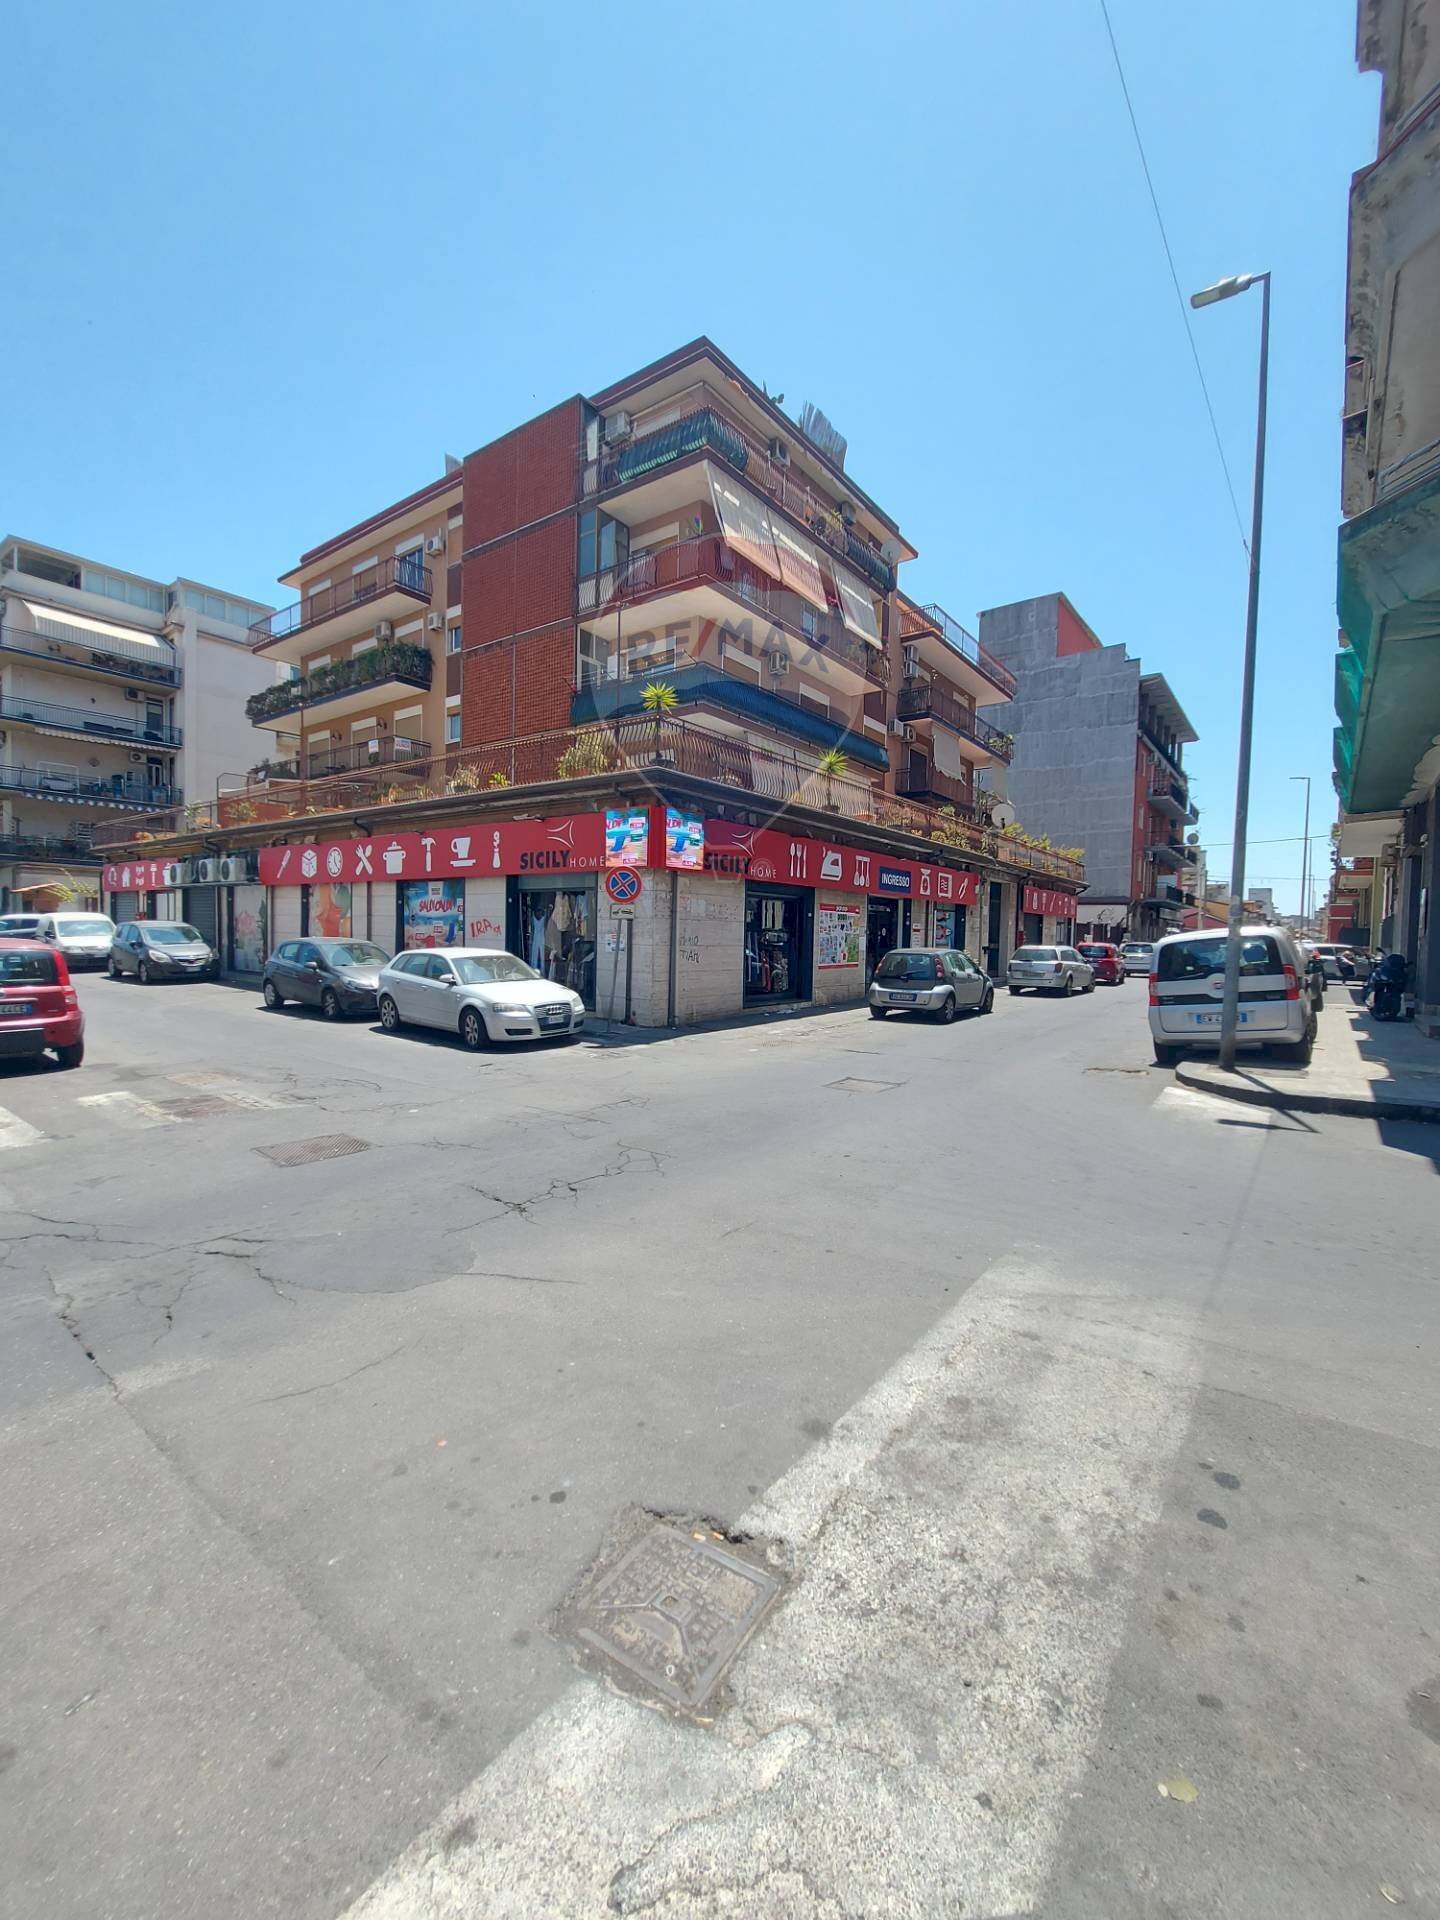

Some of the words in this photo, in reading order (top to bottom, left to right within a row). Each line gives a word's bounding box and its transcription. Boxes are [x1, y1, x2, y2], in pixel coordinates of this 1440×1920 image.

[520, 850, 570, 870] SICILY
[569, 855, 604, 868] HOME
[704, 852, 750, 875] SICILY
[750, 866, 777, 879] HOME
[881, 872, 910, 888] INGRESSO
